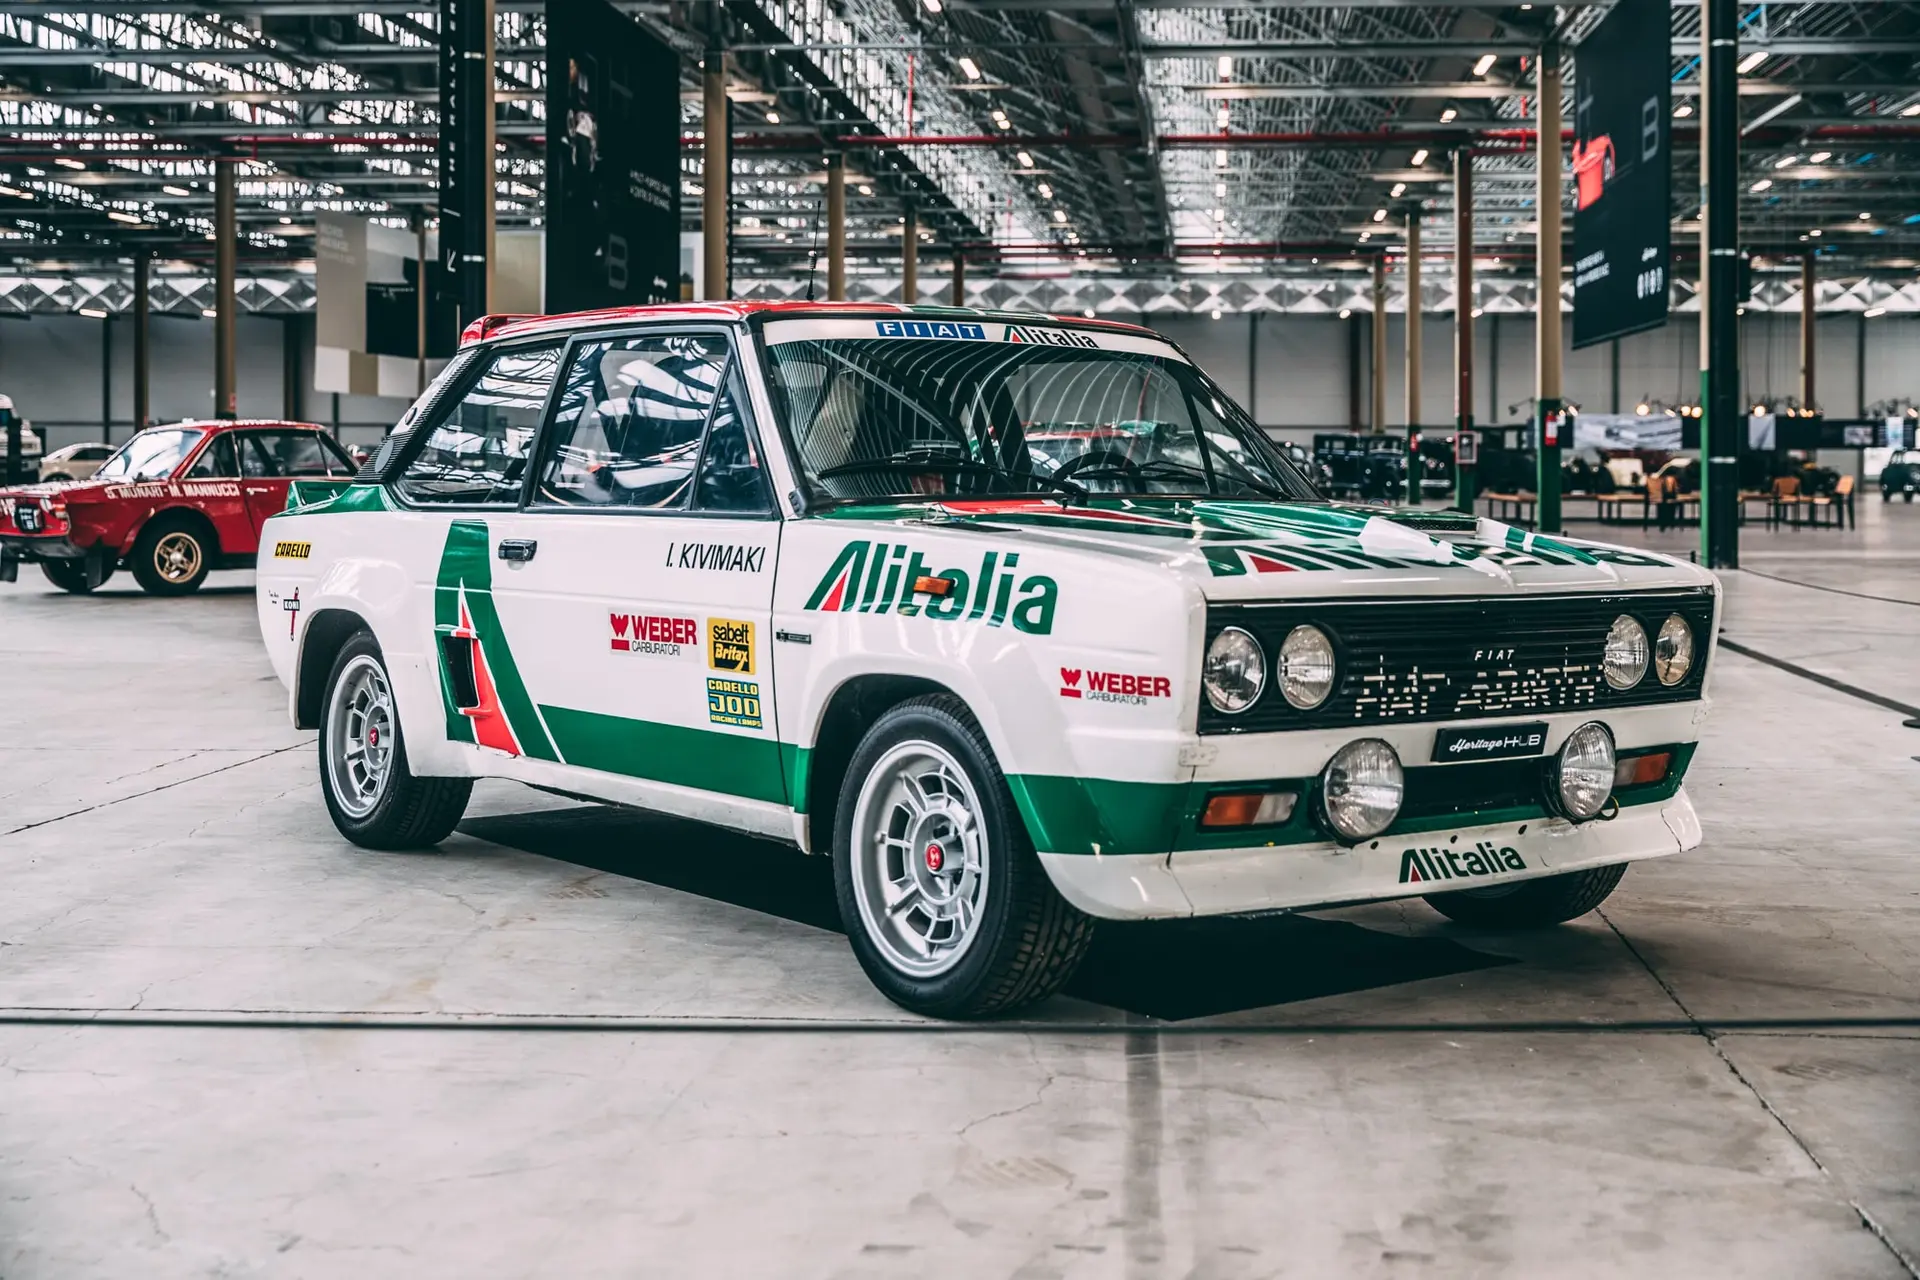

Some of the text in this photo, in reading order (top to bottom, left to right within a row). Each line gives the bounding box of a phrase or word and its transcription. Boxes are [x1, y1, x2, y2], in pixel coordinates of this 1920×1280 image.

[448, 45, 456, 127] RALLY
[880, 322, 1101, 349] FIAT Alitalia
[119, 485, 164, 499] MUNARI
[183, 483, 241, 497] MANNUCCI
[274, 542, 311, 558] CARELLO
[666, 542, 767, 573] I. KIVIMAKI
[803, 540, 1060, 636] Alitalia
[284, 600, 300, 610] KONI
[631, 614, 698, 645] WEBER
[713, 621, 749, 644] sabelt
[631, 640, 681, 656] CARBURATORI
[714, 643, 749, 665] Britax
[1474, 649, 1515, 661] FIAT
[708, 679, 758, 696] CARELLO
[1086, 670, 1171, 698] WEBER
[1086, 690, 1148, 706] CARBURATORI
[1449, 734, 1541, 753] Heritage HUB
[1398, 841, 1528, 884] Alitalia
